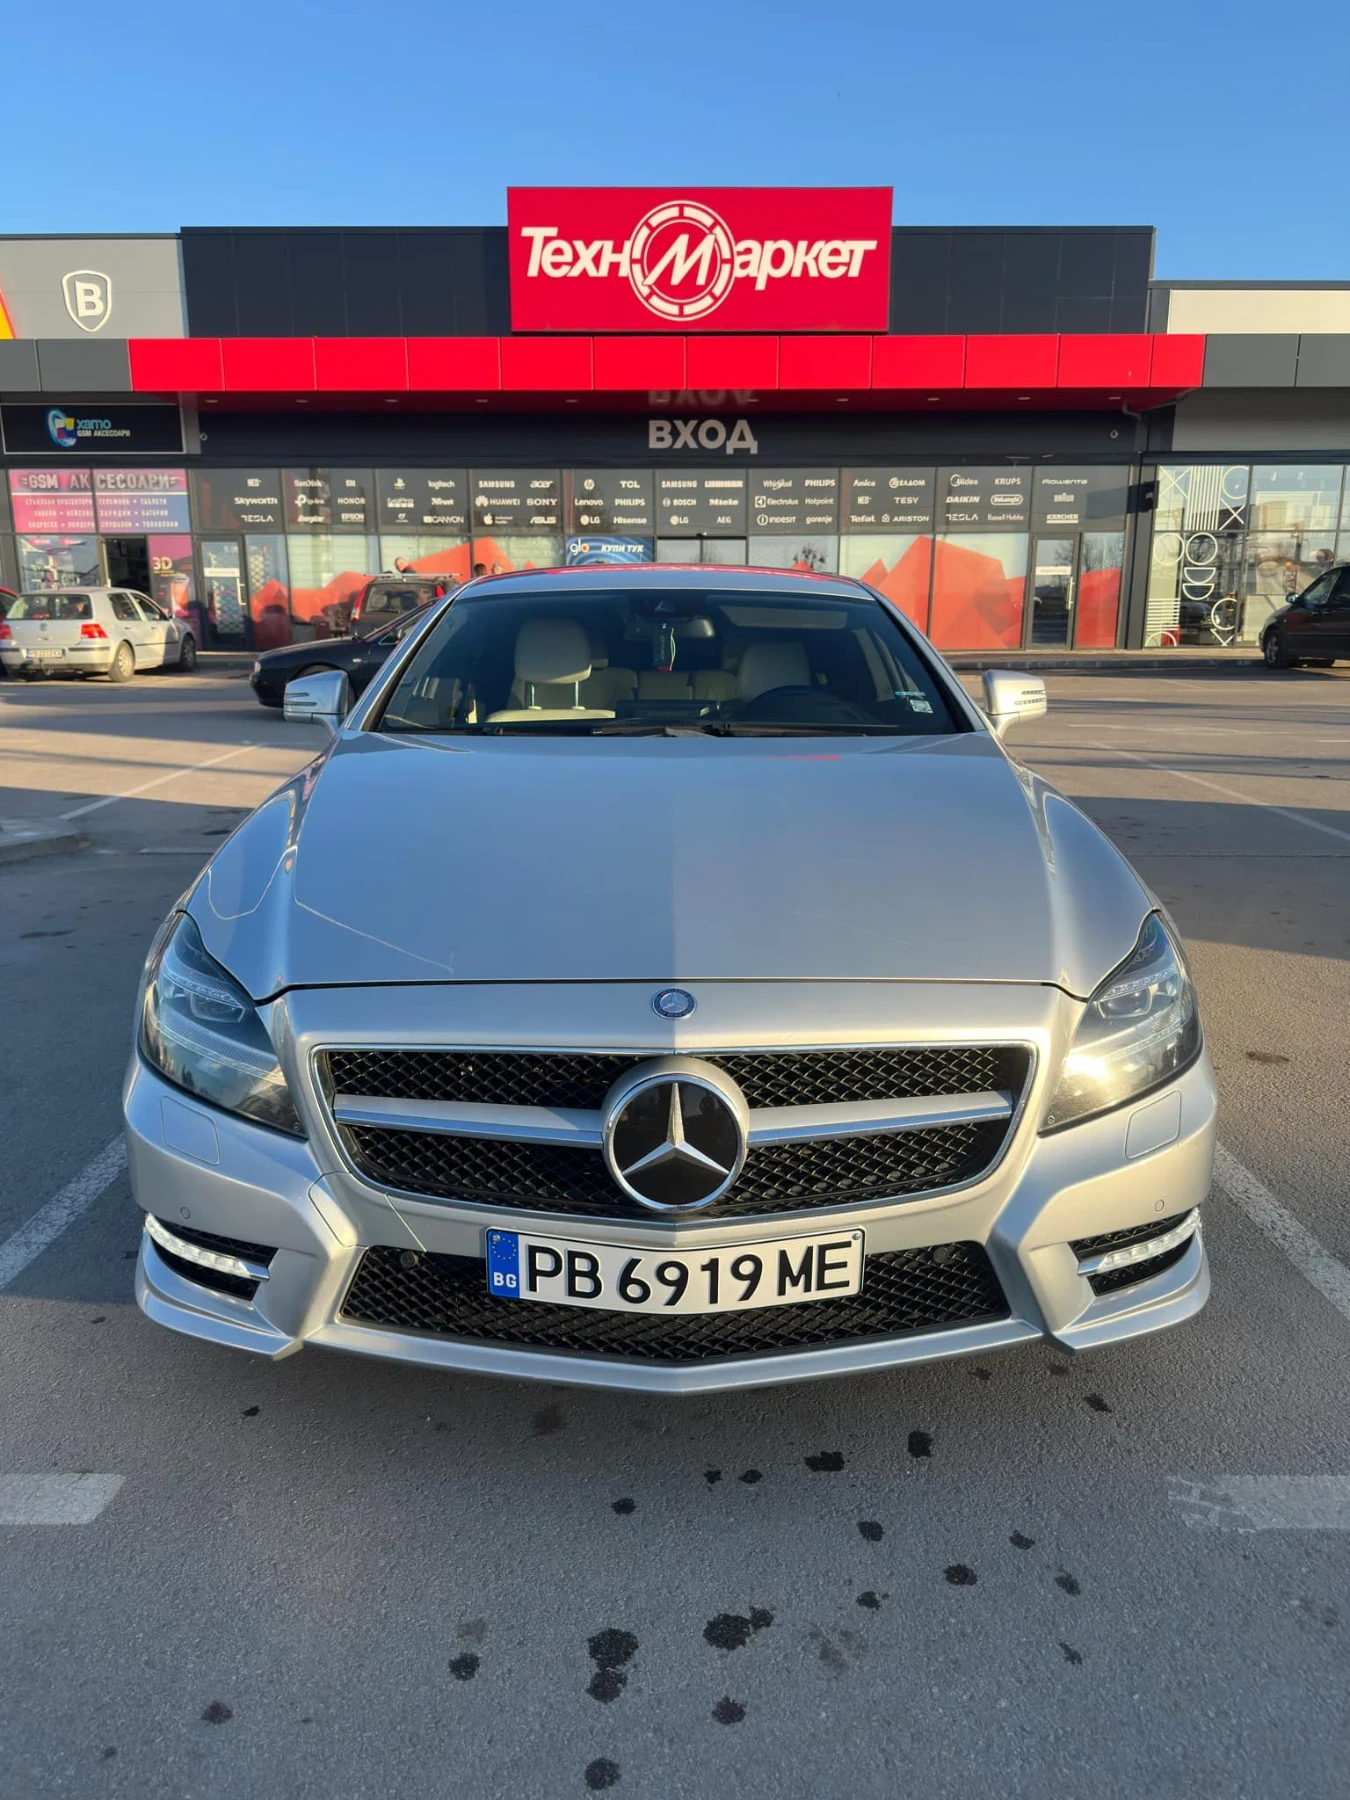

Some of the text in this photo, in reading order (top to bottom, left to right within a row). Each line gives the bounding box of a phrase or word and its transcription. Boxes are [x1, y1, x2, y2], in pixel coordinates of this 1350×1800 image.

[648, 419, 759, 455] ВХОД
[27, 473, 59, 489] GSM
[294, 479, 323, 488] SanDisk
[427, 479, 456, 490] logitech
[478, 480, 516, 488] SAMSUNG
[529, 480, 553, 488] acer
[619, 480, 640, 489] TCL
[661, 480, 698, 488] SAMSUNG
[763, 479, 793, 491] Whirlpool
[804, 479, 836, 487] PHILIPS
[852, 479, 876, 487] Amica
[955, 477, 979, 486] Midea
[994, 477, 1022, 486] KRUPS
[234, 497, 278, 506] Skyworth
[489, 498, 520, 506] HUAWEI
[526, 498, 557, 506] SONY
[574, 498, 604, 506] Lenovo
[614, 498, 646, 506] PHILIPS
[672, 498, 697, 506] BOSCH
[709, 498, 739, 506] Miele
[240, 515, 274, 523] TESLA
[530, 516, 557, 524] ASUS
[590, 516, 601, 524] LG
[613, 515, 647, 524] Hisense
[679, 516, 689, 524] LG
[716, 516, 732, 524] AEG
[805, 515, 833, 525] gorenje
[849, 514, 876, 523] Tefal
[945, 513, 979, 521] TESLA
[987, 513, 1005, 521] Russell
[570, 538, 589, 556] glo
[600, 544, 644, 553] КУПИ ТУК
[152, 556, 173, 570] 3D
[526, 1240, 851, 1306] PB 6919 ME
[493, 1272, 517, 1288] BG
